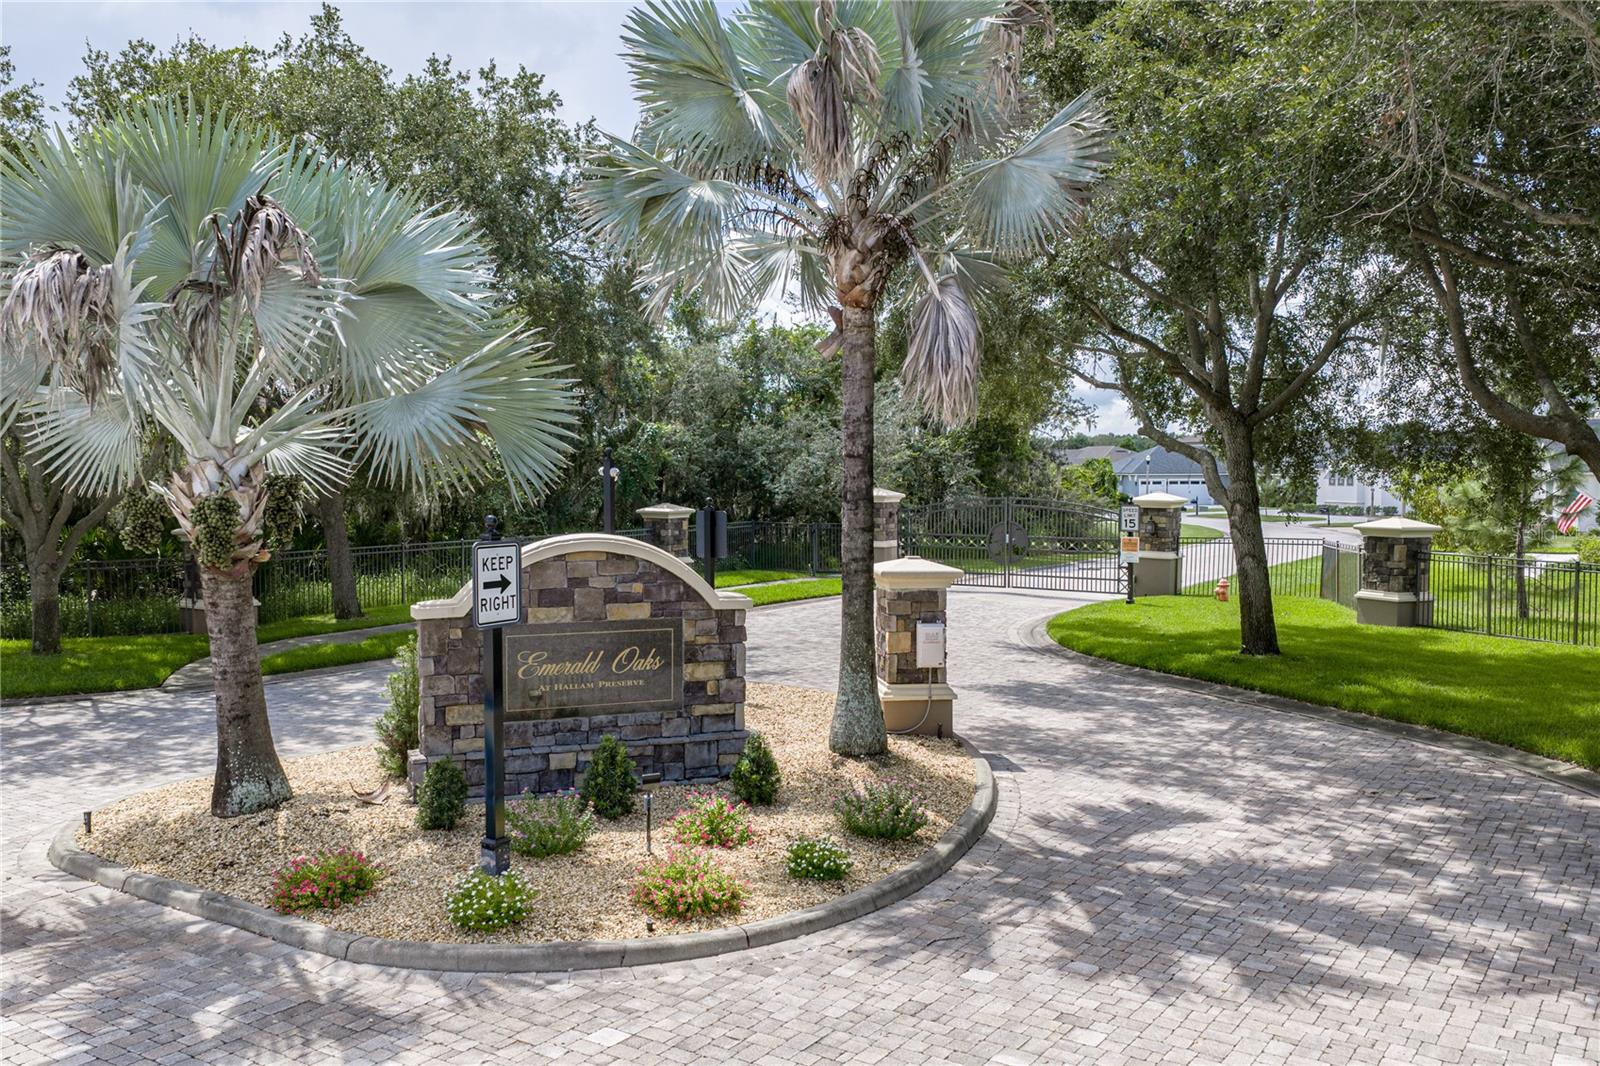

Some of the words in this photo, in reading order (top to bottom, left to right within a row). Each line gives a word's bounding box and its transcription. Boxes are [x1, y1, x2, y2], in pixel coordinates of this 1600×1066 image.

[1124, 518, 1136, 529] 15
[482, 555, 514, 572] KEEP
[480, 594, 516, 613] RIGHT
[517, 650, 604, 680] Emerald
[612, 646, 665, 674] Oaks
[554, 682, 594, 691] HALLAM
[598, 679, 645, 689] PRESERVE
